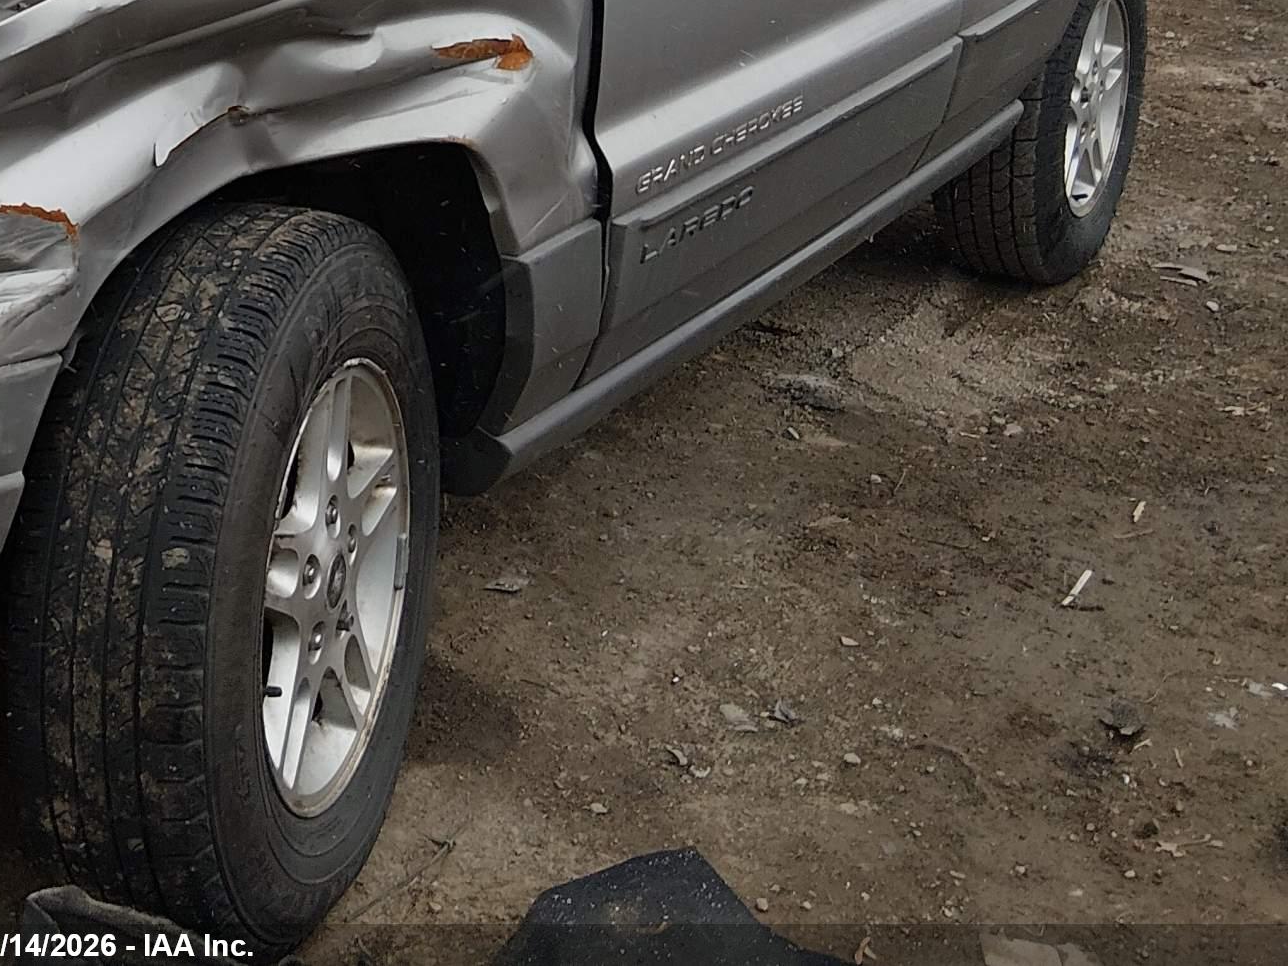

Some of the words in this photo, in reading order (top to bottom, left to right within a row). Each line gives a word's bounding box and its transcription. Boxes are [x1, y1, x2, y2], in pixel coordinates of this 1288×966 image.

[635, 144, 705, 195] GRAND
[710, 95, 804, 155] CHEROKEE
[640, 185, 754, 264] LAREDO
